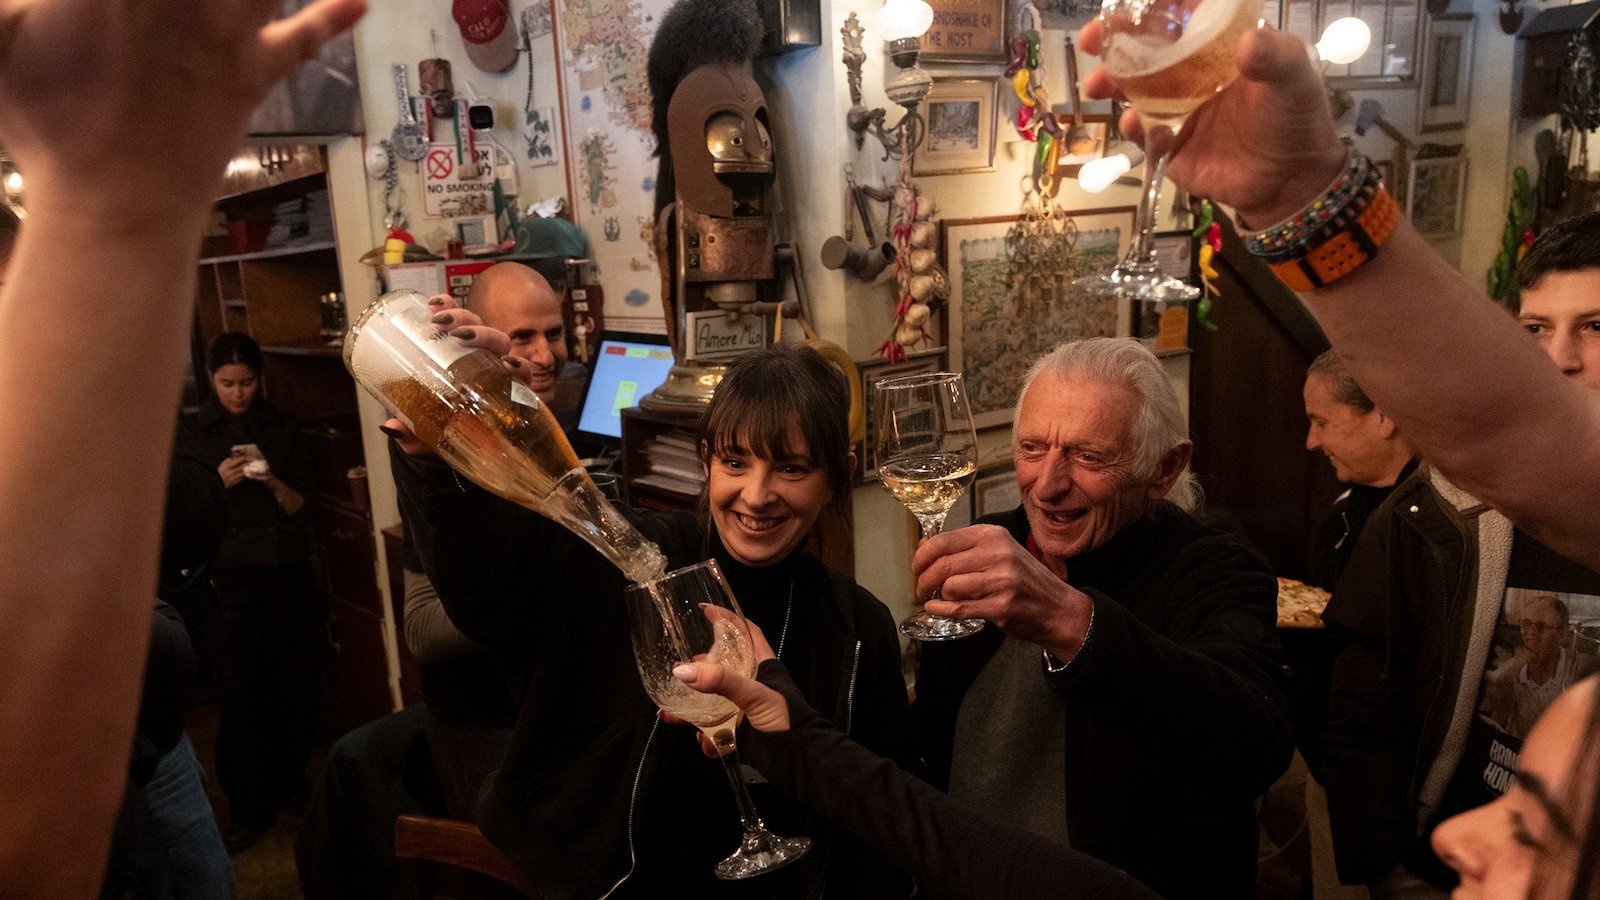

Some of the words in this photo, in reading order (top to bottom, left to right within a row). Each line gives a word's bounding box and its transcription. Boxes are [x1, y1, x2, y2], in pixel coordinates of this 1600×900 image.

[930, 9, 978, 28] ANDSHAKE
[924, 31, 941, 46] THE
[947, 31, 973, 47] HOST
[427, 184, 443, 194] NO
[446, 182, 495, 193] SMOKING
[699, 323, 737, 349] Amore
[740, 323, 761, 345] Mio
[1483, 761, 1516, 795] HOM
